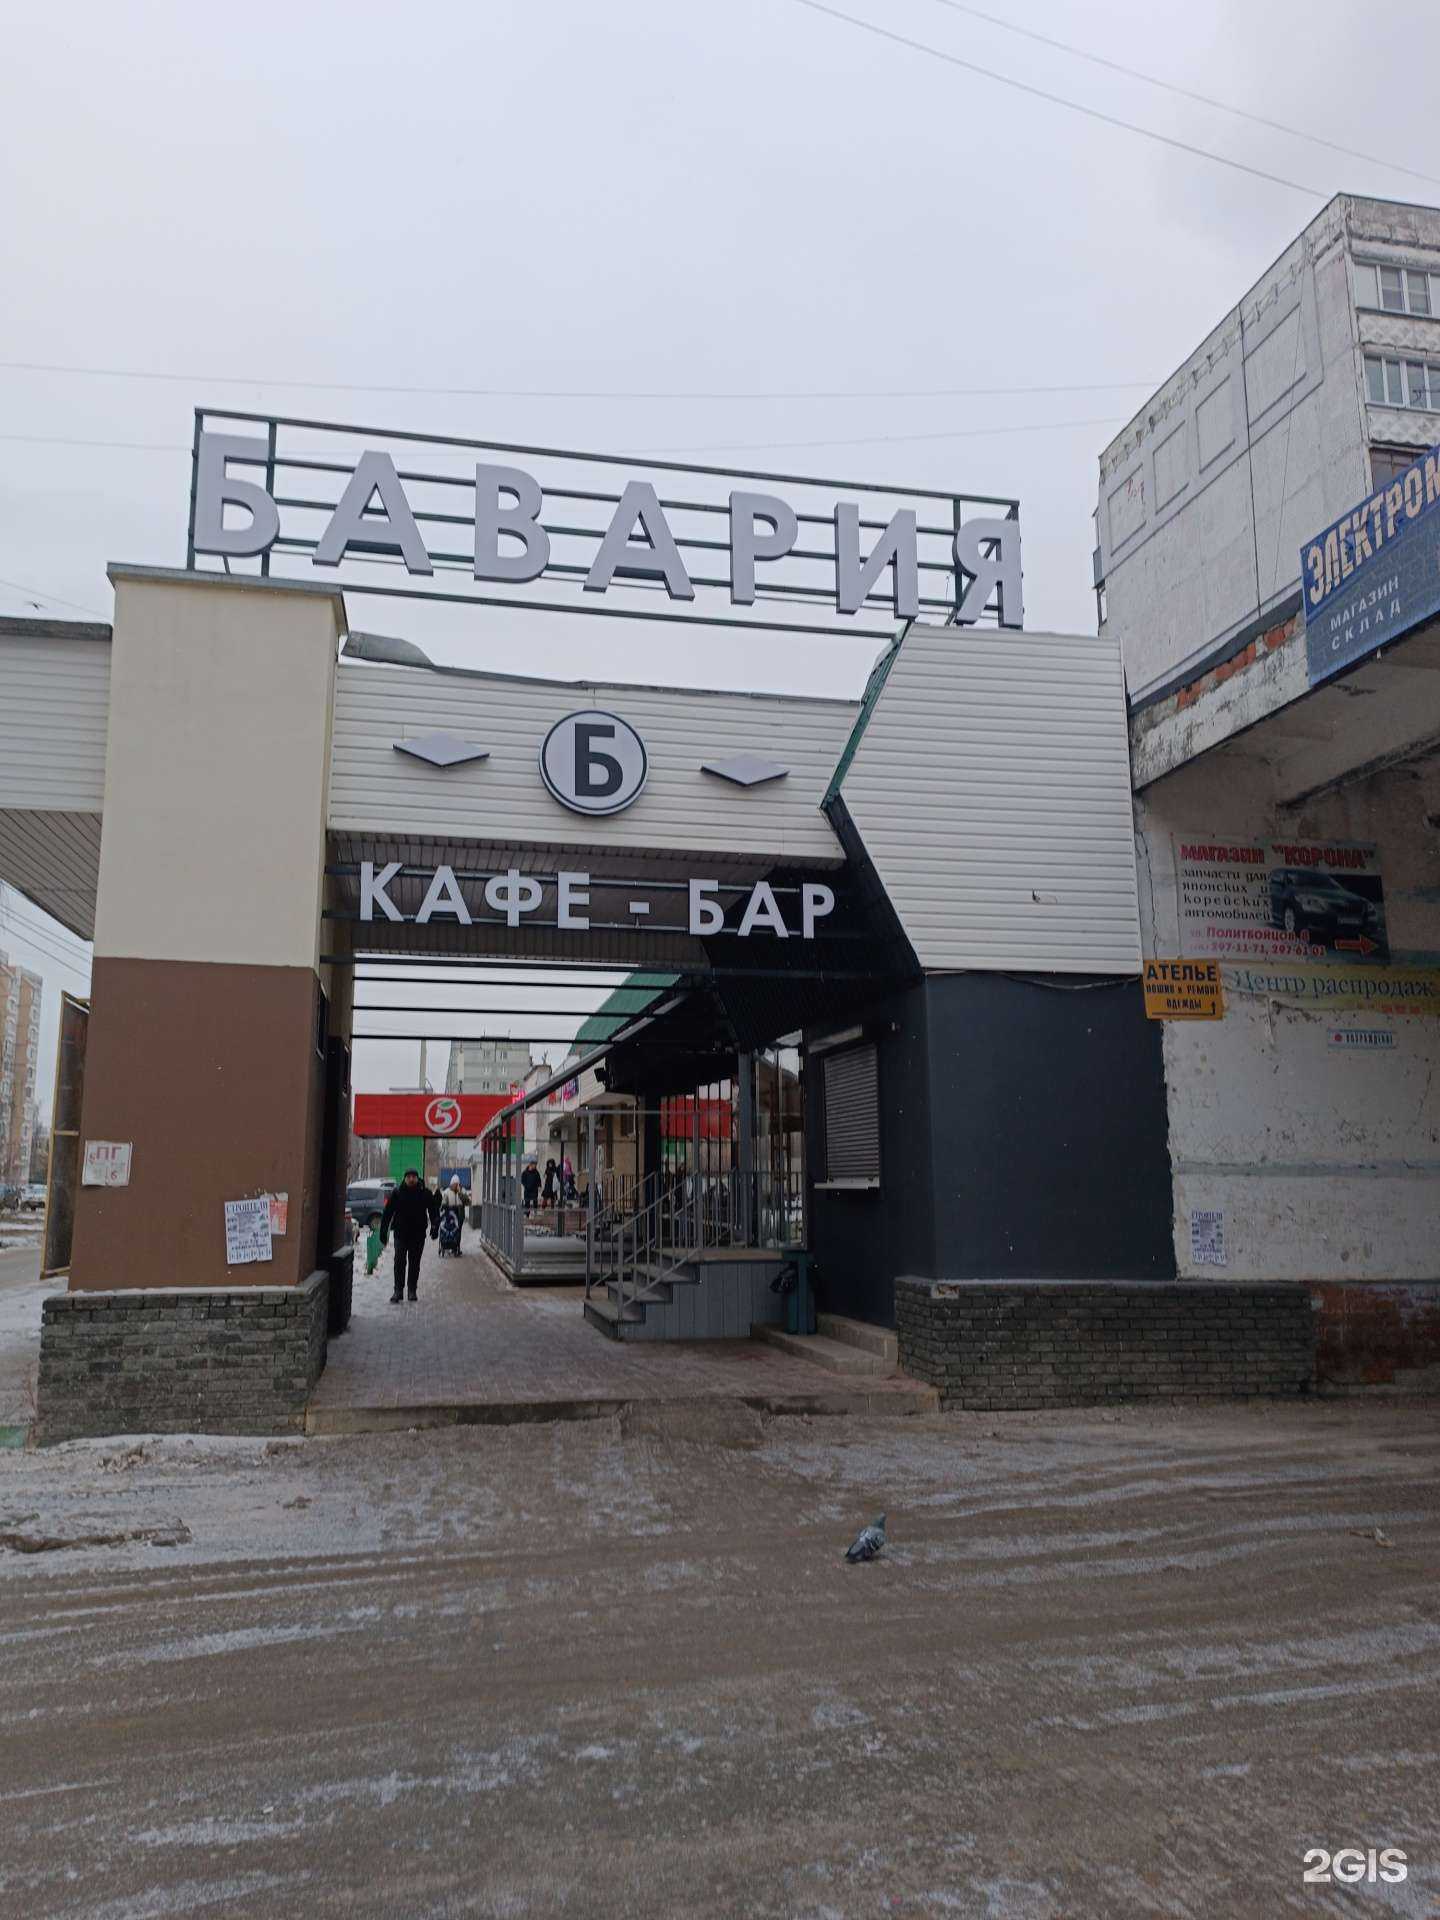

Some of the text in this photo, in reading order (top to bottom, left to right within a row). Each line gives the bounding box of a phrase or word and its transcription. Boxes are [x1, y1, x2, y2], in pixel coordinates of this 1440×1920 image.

[193, 432, 1024, 630] БАВАРИЯ
[1329, 574, 1400, 631] МАГАЗИН
[1331, 598, 1401, 651] СКЛАД
[574, 722, 624, 798] Б
[359, 860, 590, 931] КАФЕ
[689, 877, 835, 939] БАР
[1182, 881, 1248, 894] японских
[1146, 964, 1218, 981] АТЕЛЬЕ
[1234, 969, 1307, 994] Центр
